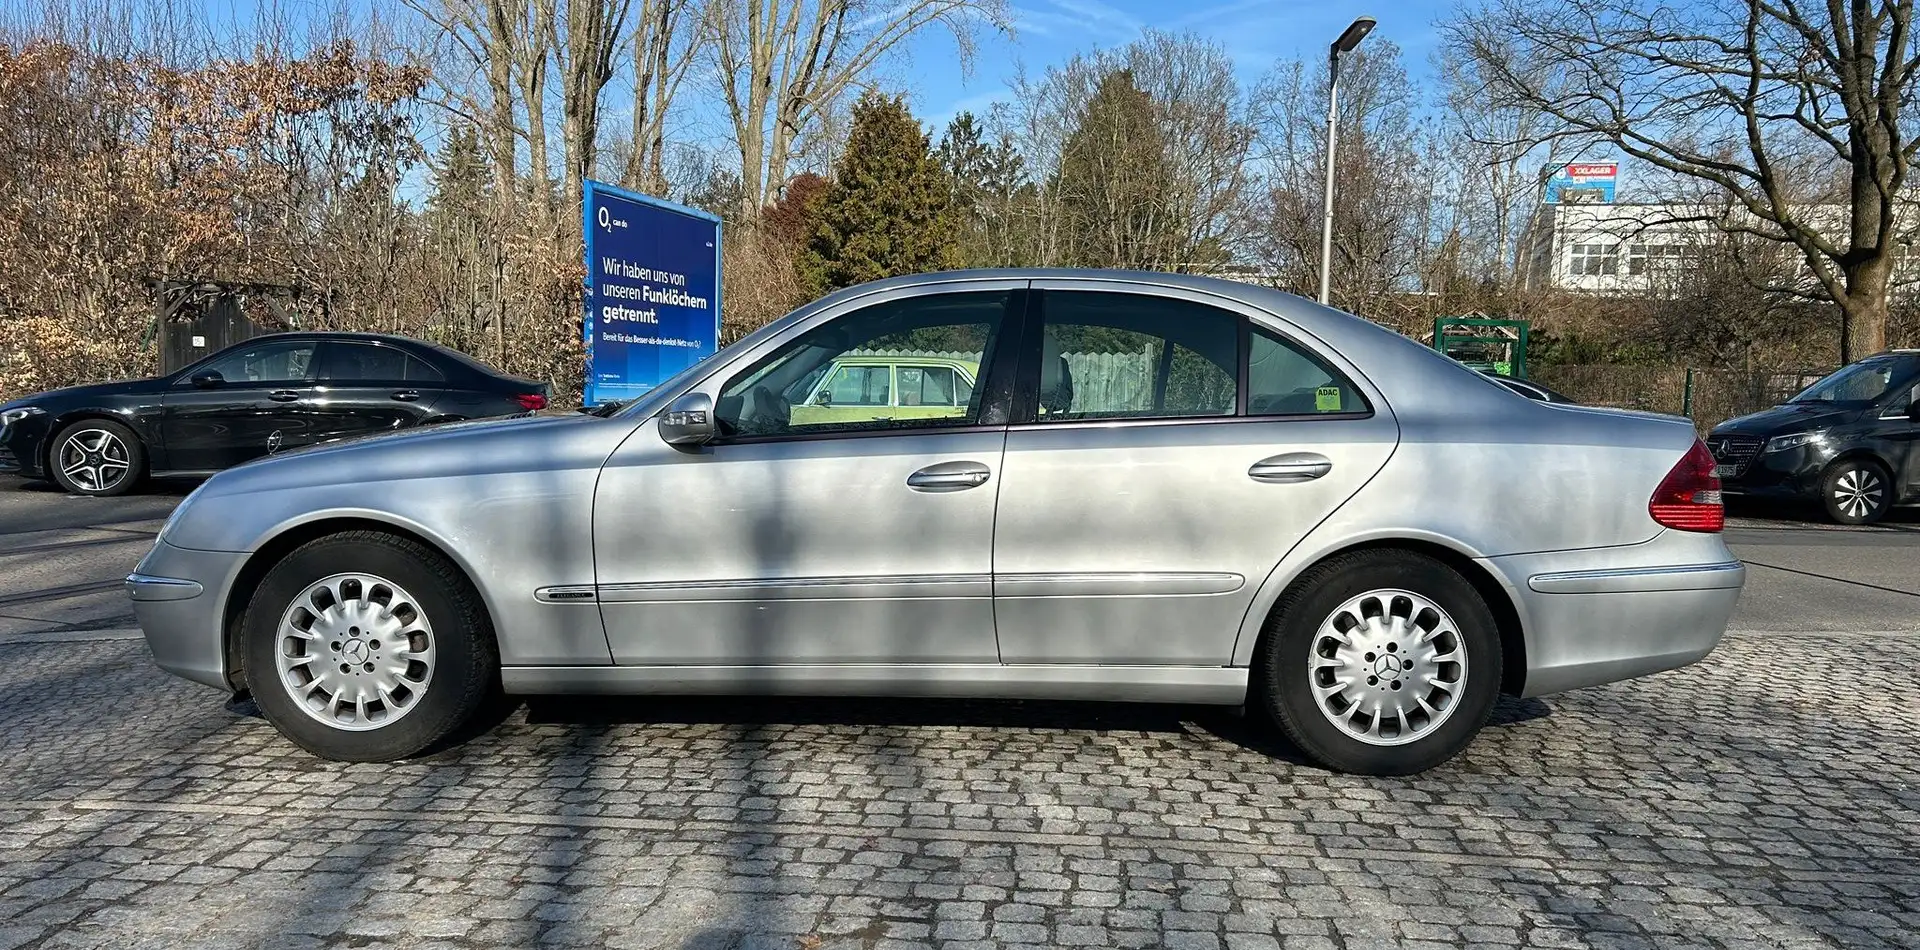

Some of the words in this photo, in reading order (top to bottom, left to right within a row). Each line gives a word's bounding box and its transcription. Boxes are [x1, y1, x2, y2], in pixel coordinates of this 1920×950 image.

[612, 219, 621, 227] can
[621, 220, 628, 228] do
[602, 256, 621, 276] Wir
[622, 260, 651, 281] haben
[653, 270, 668, 284] uns
[669, 272, 685, 286] von
[602, 283, 641, 300] unseren
[642, 285, 707, 309] Funklöchern
[602, 304, 658, 324] getrennt.
[602, 331, 617, 341] Bereit
[624, 334, 633, 343] das
